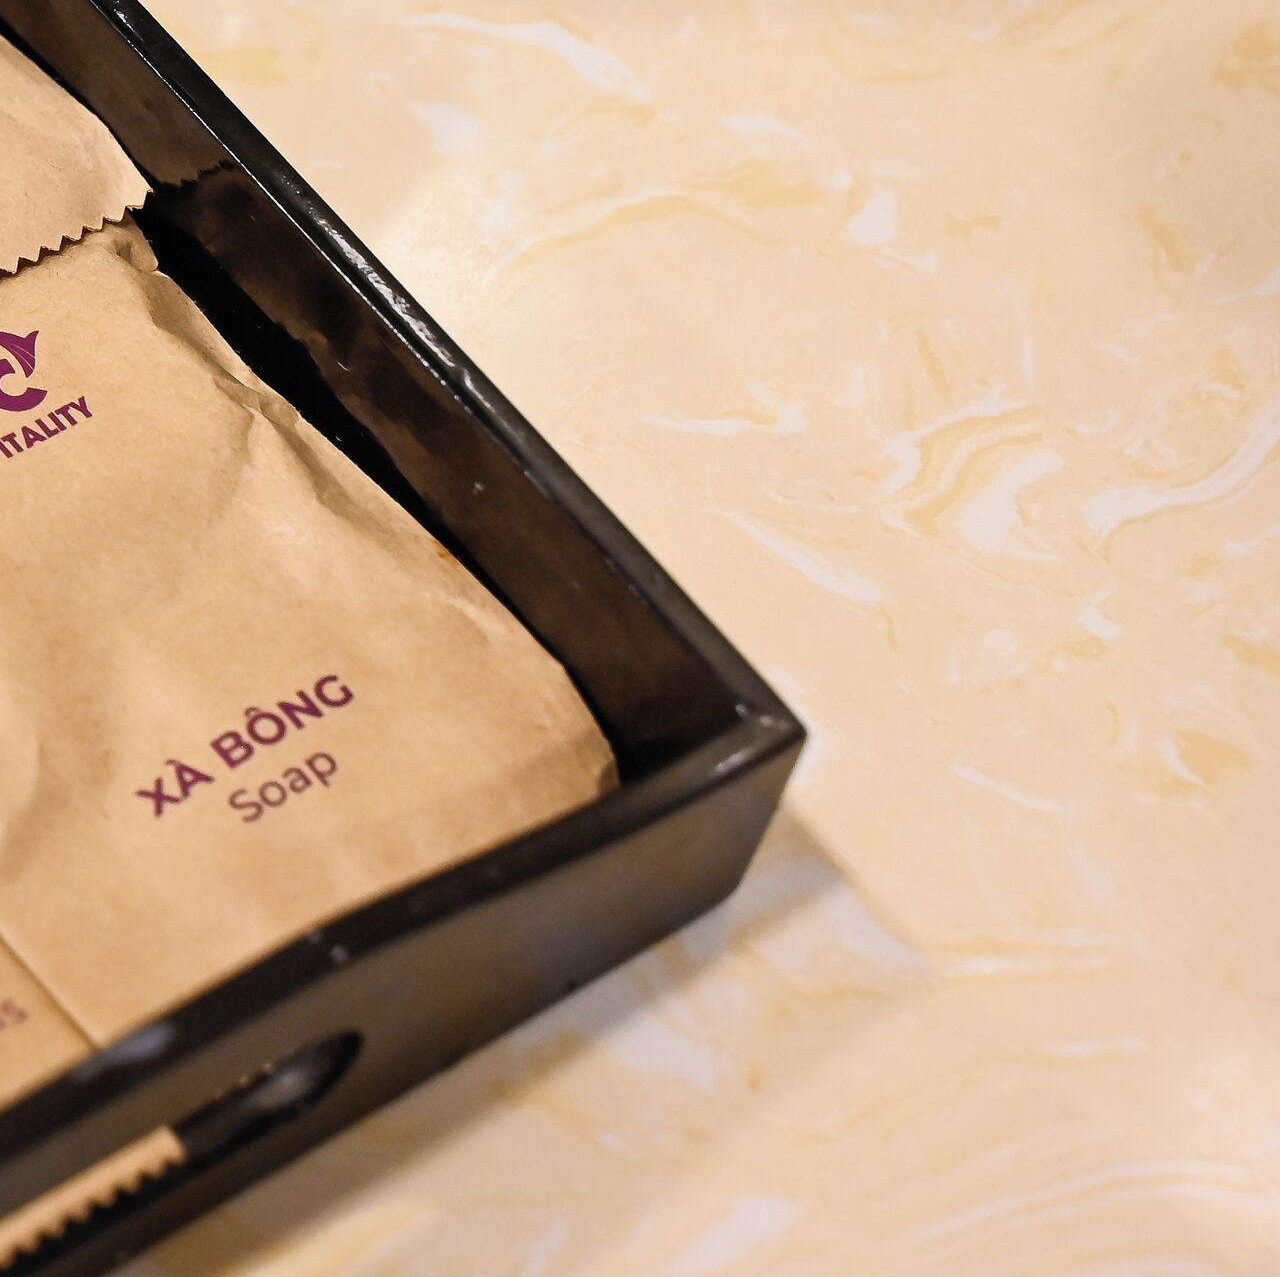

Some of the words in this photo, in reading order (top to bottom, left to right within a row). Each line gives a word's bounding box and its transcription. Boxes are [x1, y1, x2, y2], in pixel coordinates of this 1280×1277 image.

[135, 759, 214, 820] XÀ
[210, 673, 355, 772] BÔNG
[227, 745, 342, 826] Soap
